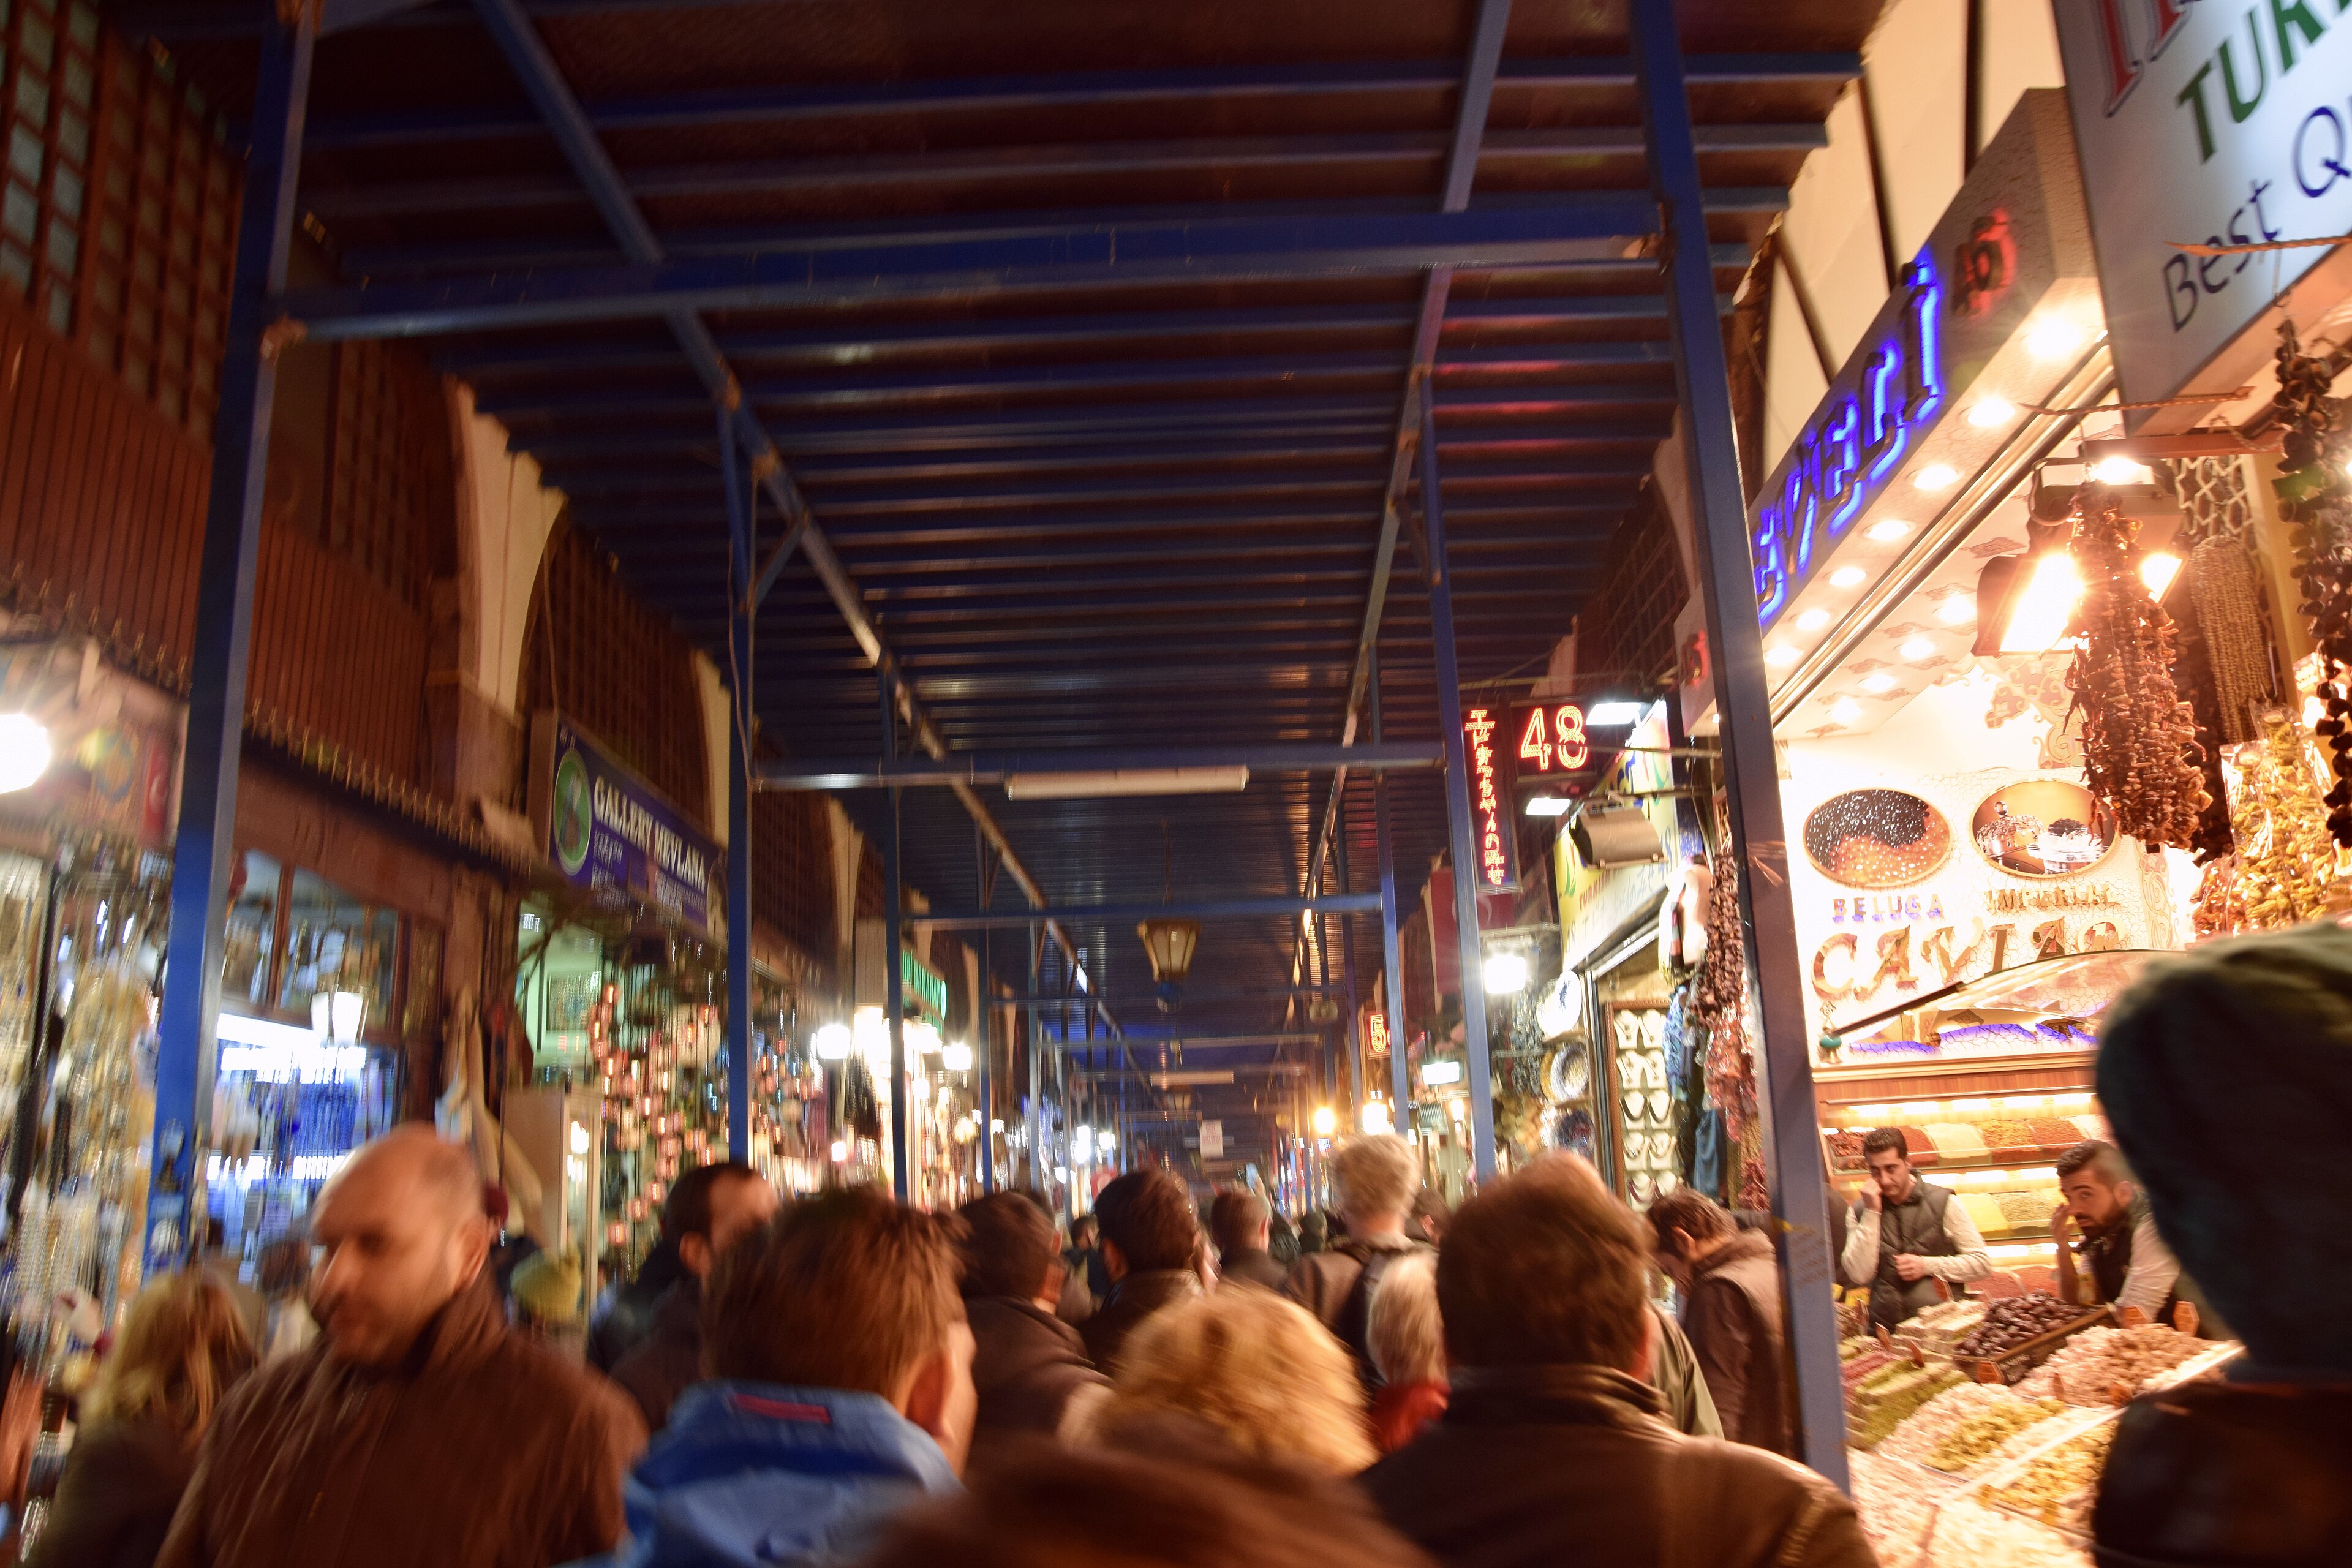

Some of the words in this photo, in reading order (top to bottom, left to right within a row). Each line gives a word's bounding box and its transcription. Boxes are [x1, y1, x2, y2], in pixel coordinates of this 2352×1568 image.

[1520, 704, 1588, 771] 48
[594, 774, 654, 856] GALLERY
[1833, 893, 1945, 921] BELUGA
[1986, 883, 2117, 910] IMPERIAL
